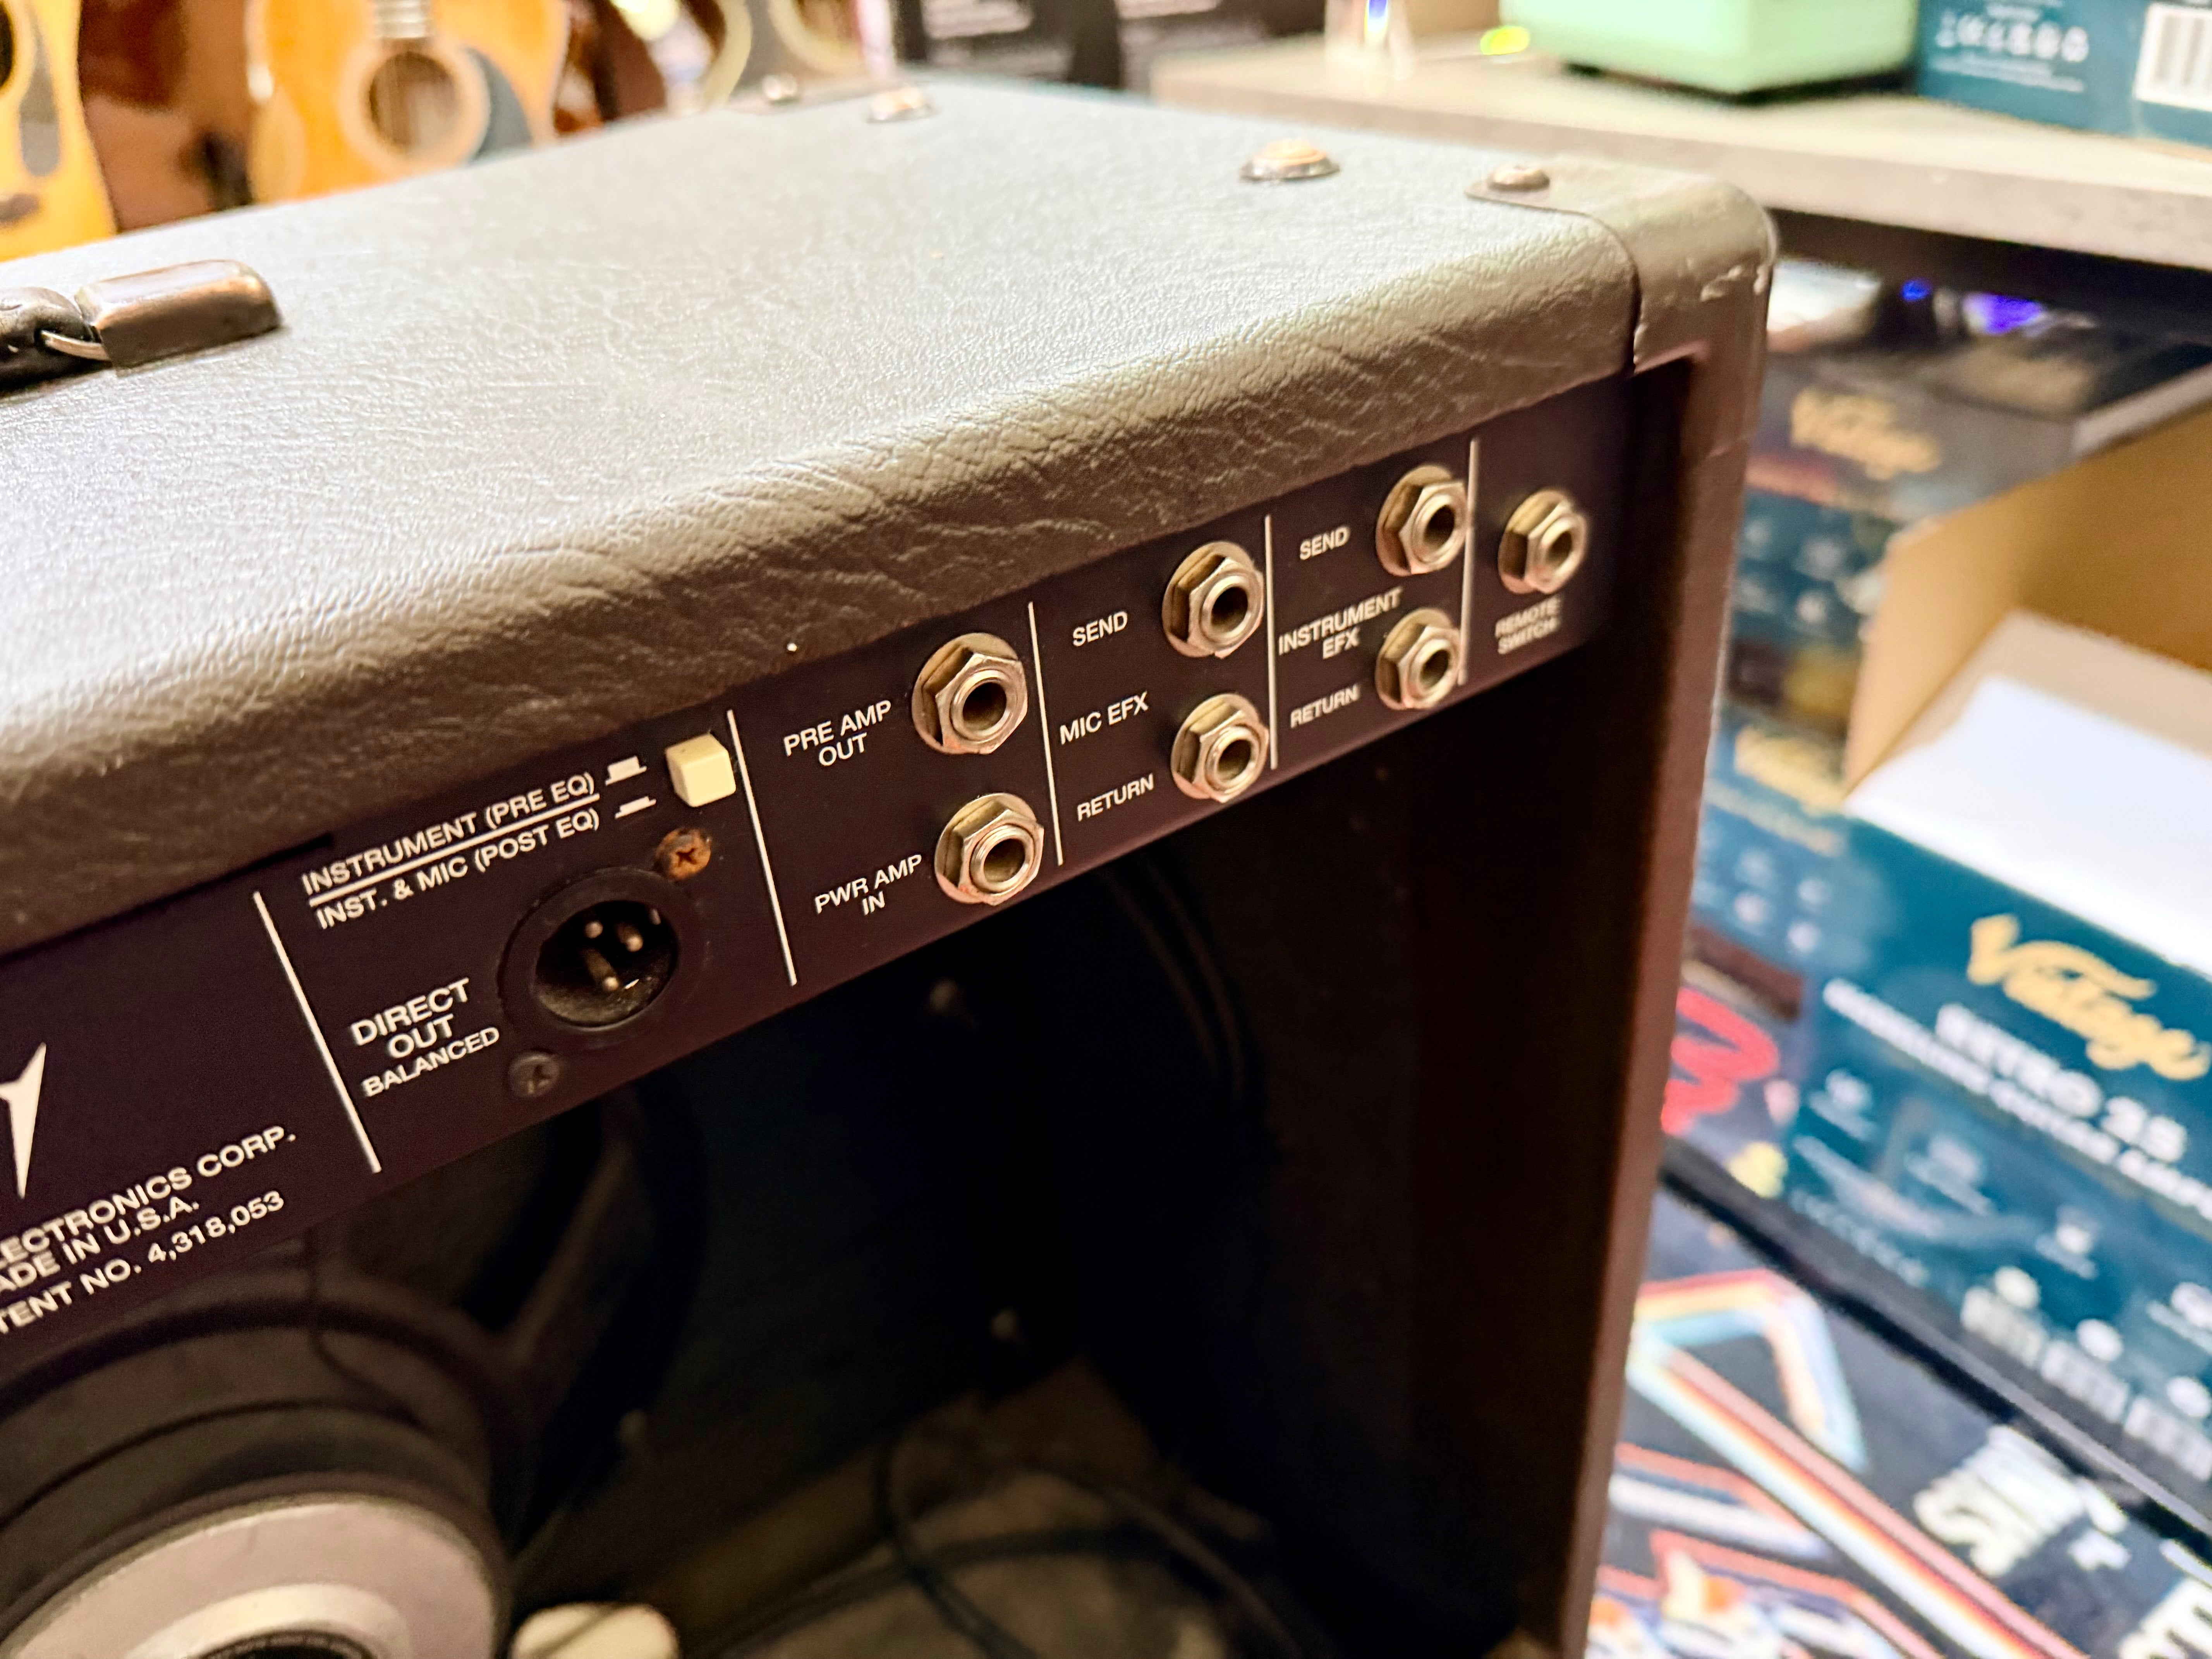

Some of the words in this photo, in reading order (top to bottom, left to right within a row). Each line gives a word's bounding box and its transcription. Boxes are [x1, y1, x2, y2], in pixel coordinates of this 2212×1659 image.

[1300, 526, 1350, 560] SEND
[1073, 611, 1128, 647] SEND
[1279, 586, 1403, 655] INSTRUMENT
[1322, 627, 1360, 659] EFX
[1495, 595, 1561, 638] REMOTE
[1497, 616, 1560, 655] SWITCH
[783, 721, 834, 756] PRE
[840, 700, 891, 736] AMP
[1060, 712, 1102, 745] MIC
[1108, 692, 1148, 725] EFX
[1290, 684, 1360, 728] RETURN
[819, 732, 867, 766] OUT
[1077, 773, 1154, 821] RETURN
[302, 812, 476, 895] INSTRUMENT
[485, 789, 546, 830] (PRE
[551, 772, 596, 805] EQ)
[316, 888, 388, 929] INST.
[392, 878, 412, 900] &
[416, 857, 468, 891] MIC
[474, 824, 549, 872] (POST
[556, 808, 599, 838] EQ)
[815, 878, 869, 914] PWR
[874, 855, 922, 889] AMP
[862, 891, 885, 915] IN
[350, 978, 469, 1046] DIRECT
[388, 1014, 453, 1058] OUT
[362, 1027, 499, 1097] BALANCED
[0, 1167, 192, 1267] ECTRONICS
[197, 1126, 295, 1177] CORP.
[62, 1233, 101, 1264] IN
[103, 1196, 199, 1244] U.S.A.
[80, 1259, 141, 1294] NO.
[148, 1191, 284, 1262] 4,318,053
